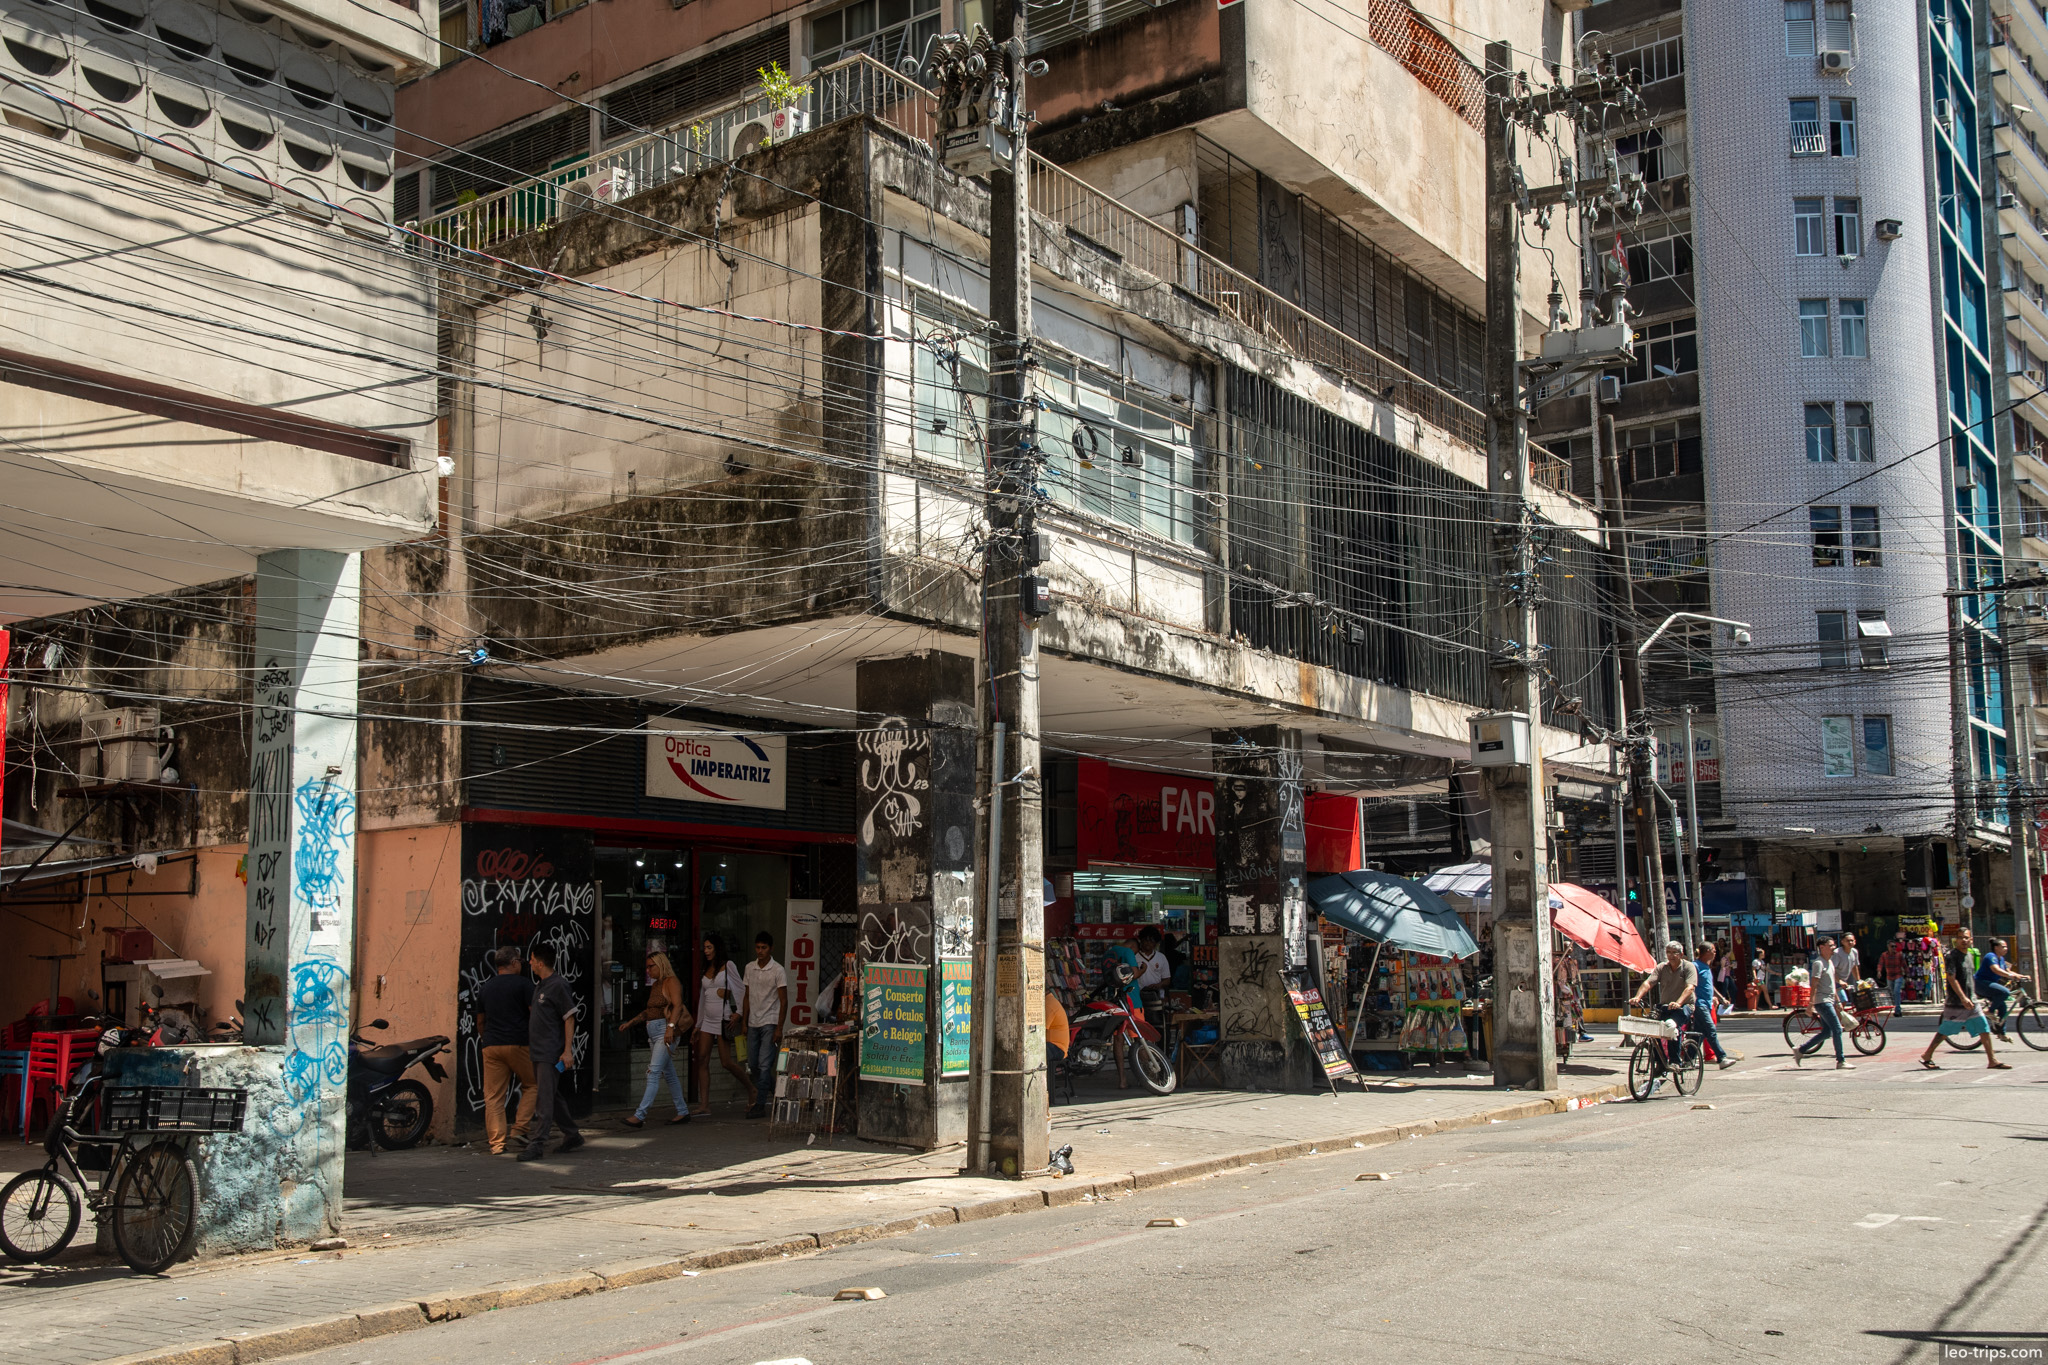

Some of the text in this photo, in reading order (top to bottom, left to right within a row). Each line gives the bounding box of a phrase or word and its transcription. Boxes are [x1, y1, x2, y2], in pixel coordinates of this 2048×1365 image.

[665, 736, 711, 758] Optica
[691, 758, 771, 784] IMPERATRIZ
[1162, 786, 1216, 836] FAR
[649, 917, 677, 929] ABERTO
[865, 967, 926, 987] JANAINA
[885, 988, 924, 1003] Conserto
[883, 1004, 924, 1022] de Óculos
[956, 1002, 963, 1014] de
[883, 1027, 922, 1044] e Relógio
[872, 1042, 901, 1052] Banho
[866, 1053, 890, 1062] solda
